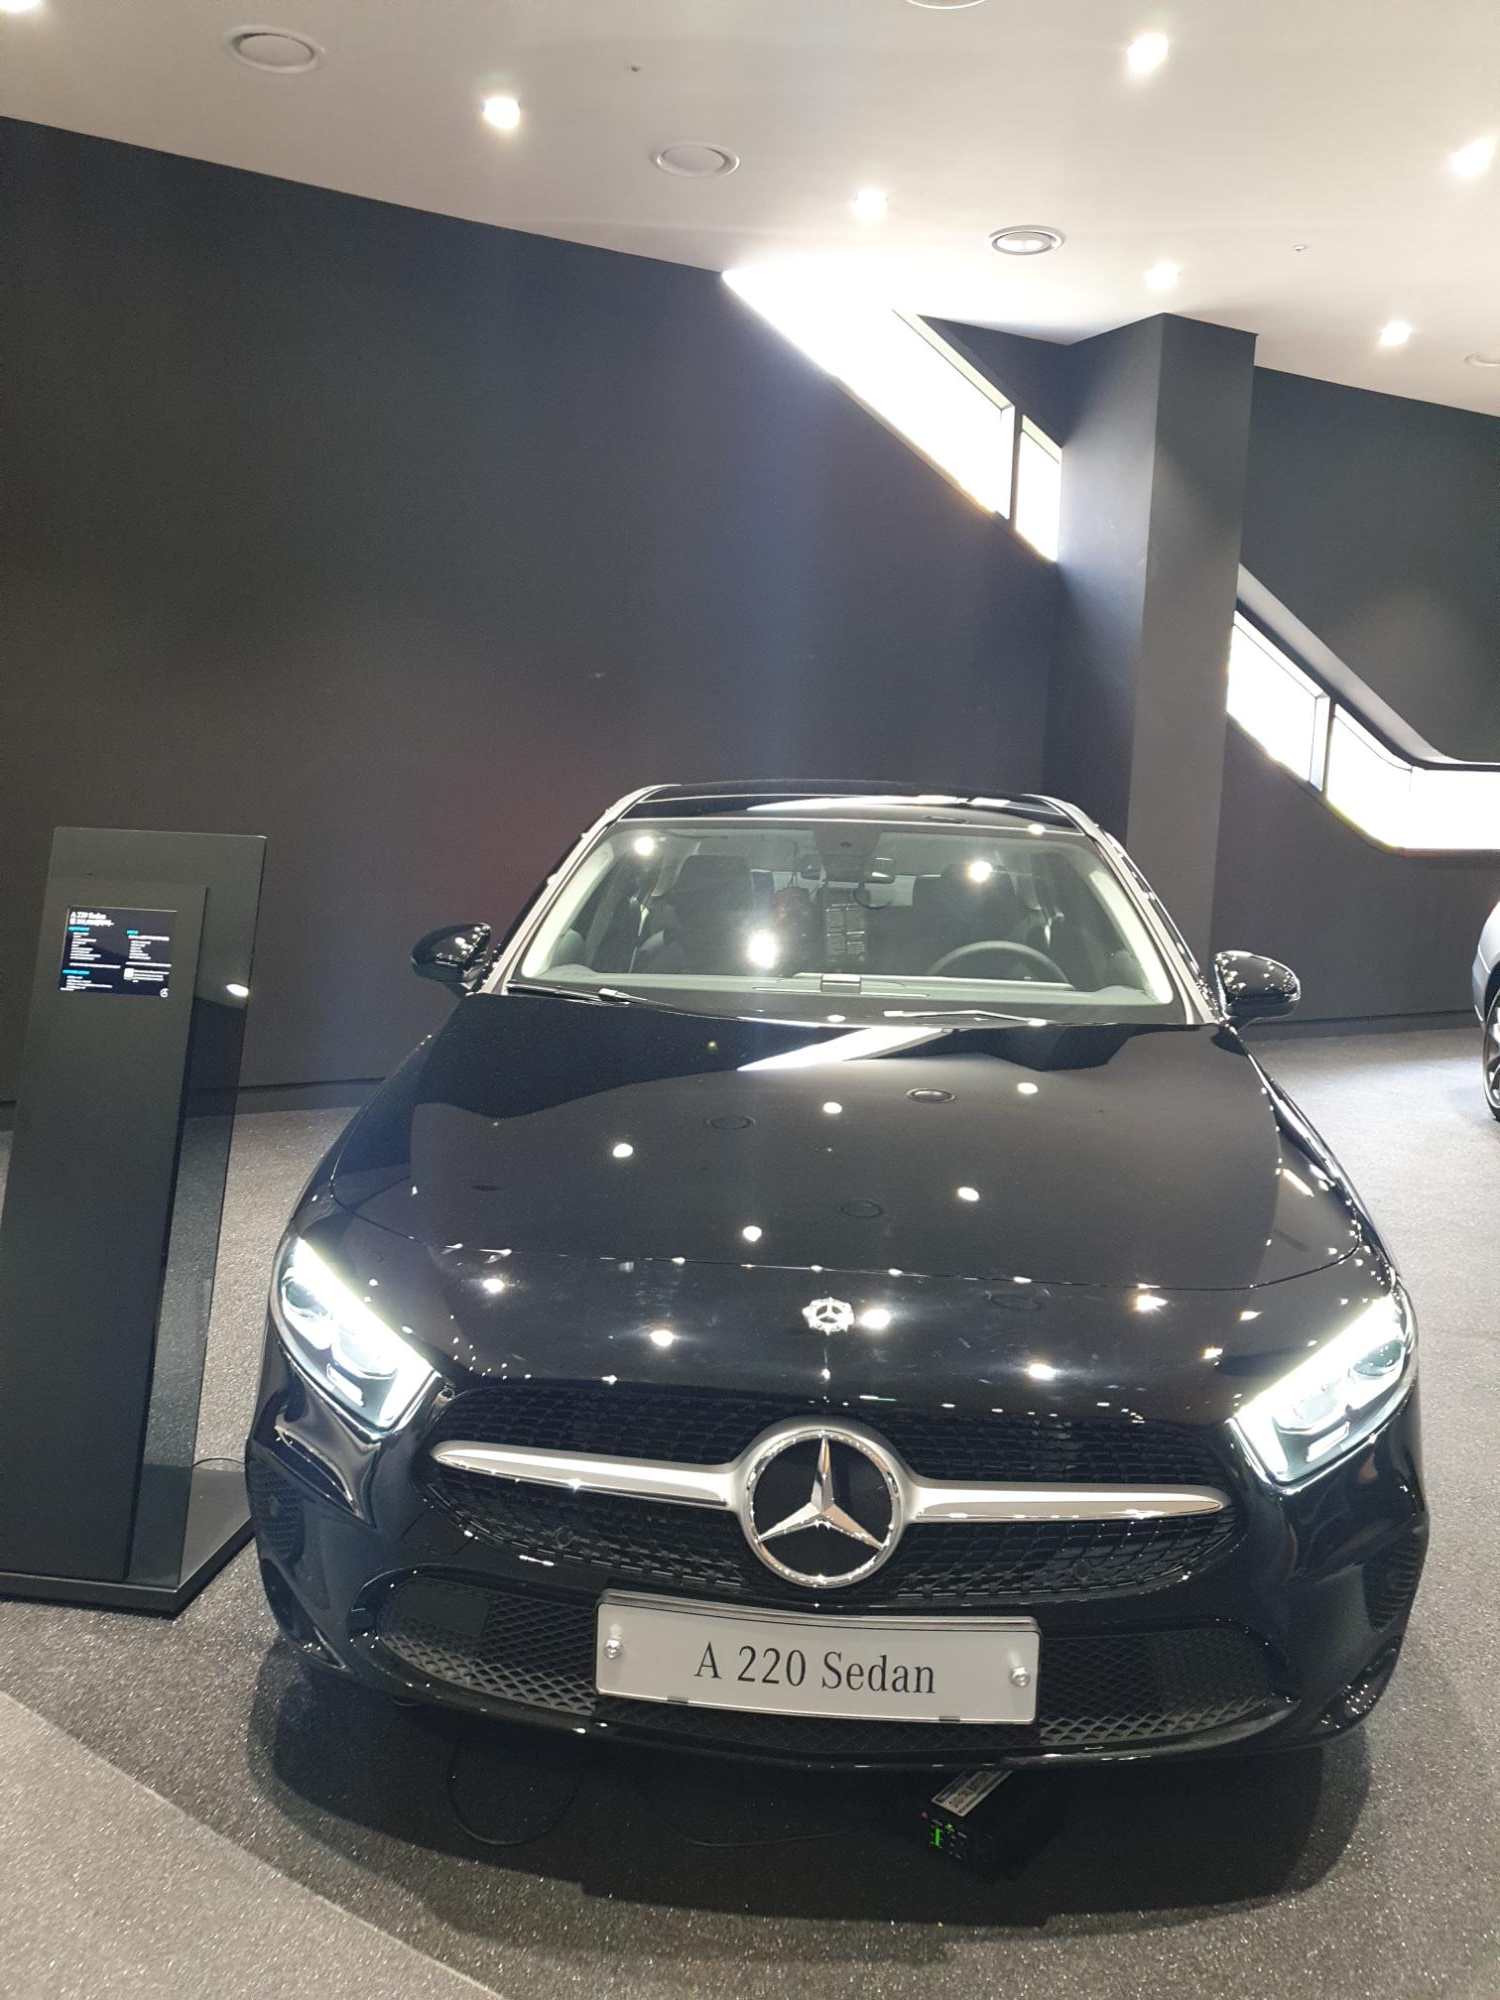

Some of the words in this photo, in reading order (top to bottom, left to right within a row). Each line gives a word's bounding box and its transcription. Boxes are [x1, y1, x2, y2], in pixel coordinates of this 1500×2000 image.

[694, 1642, 722, 1680] A
[737, 1645, 806, 1687] 220
[821, 1651, 935, 1694] Sedan
